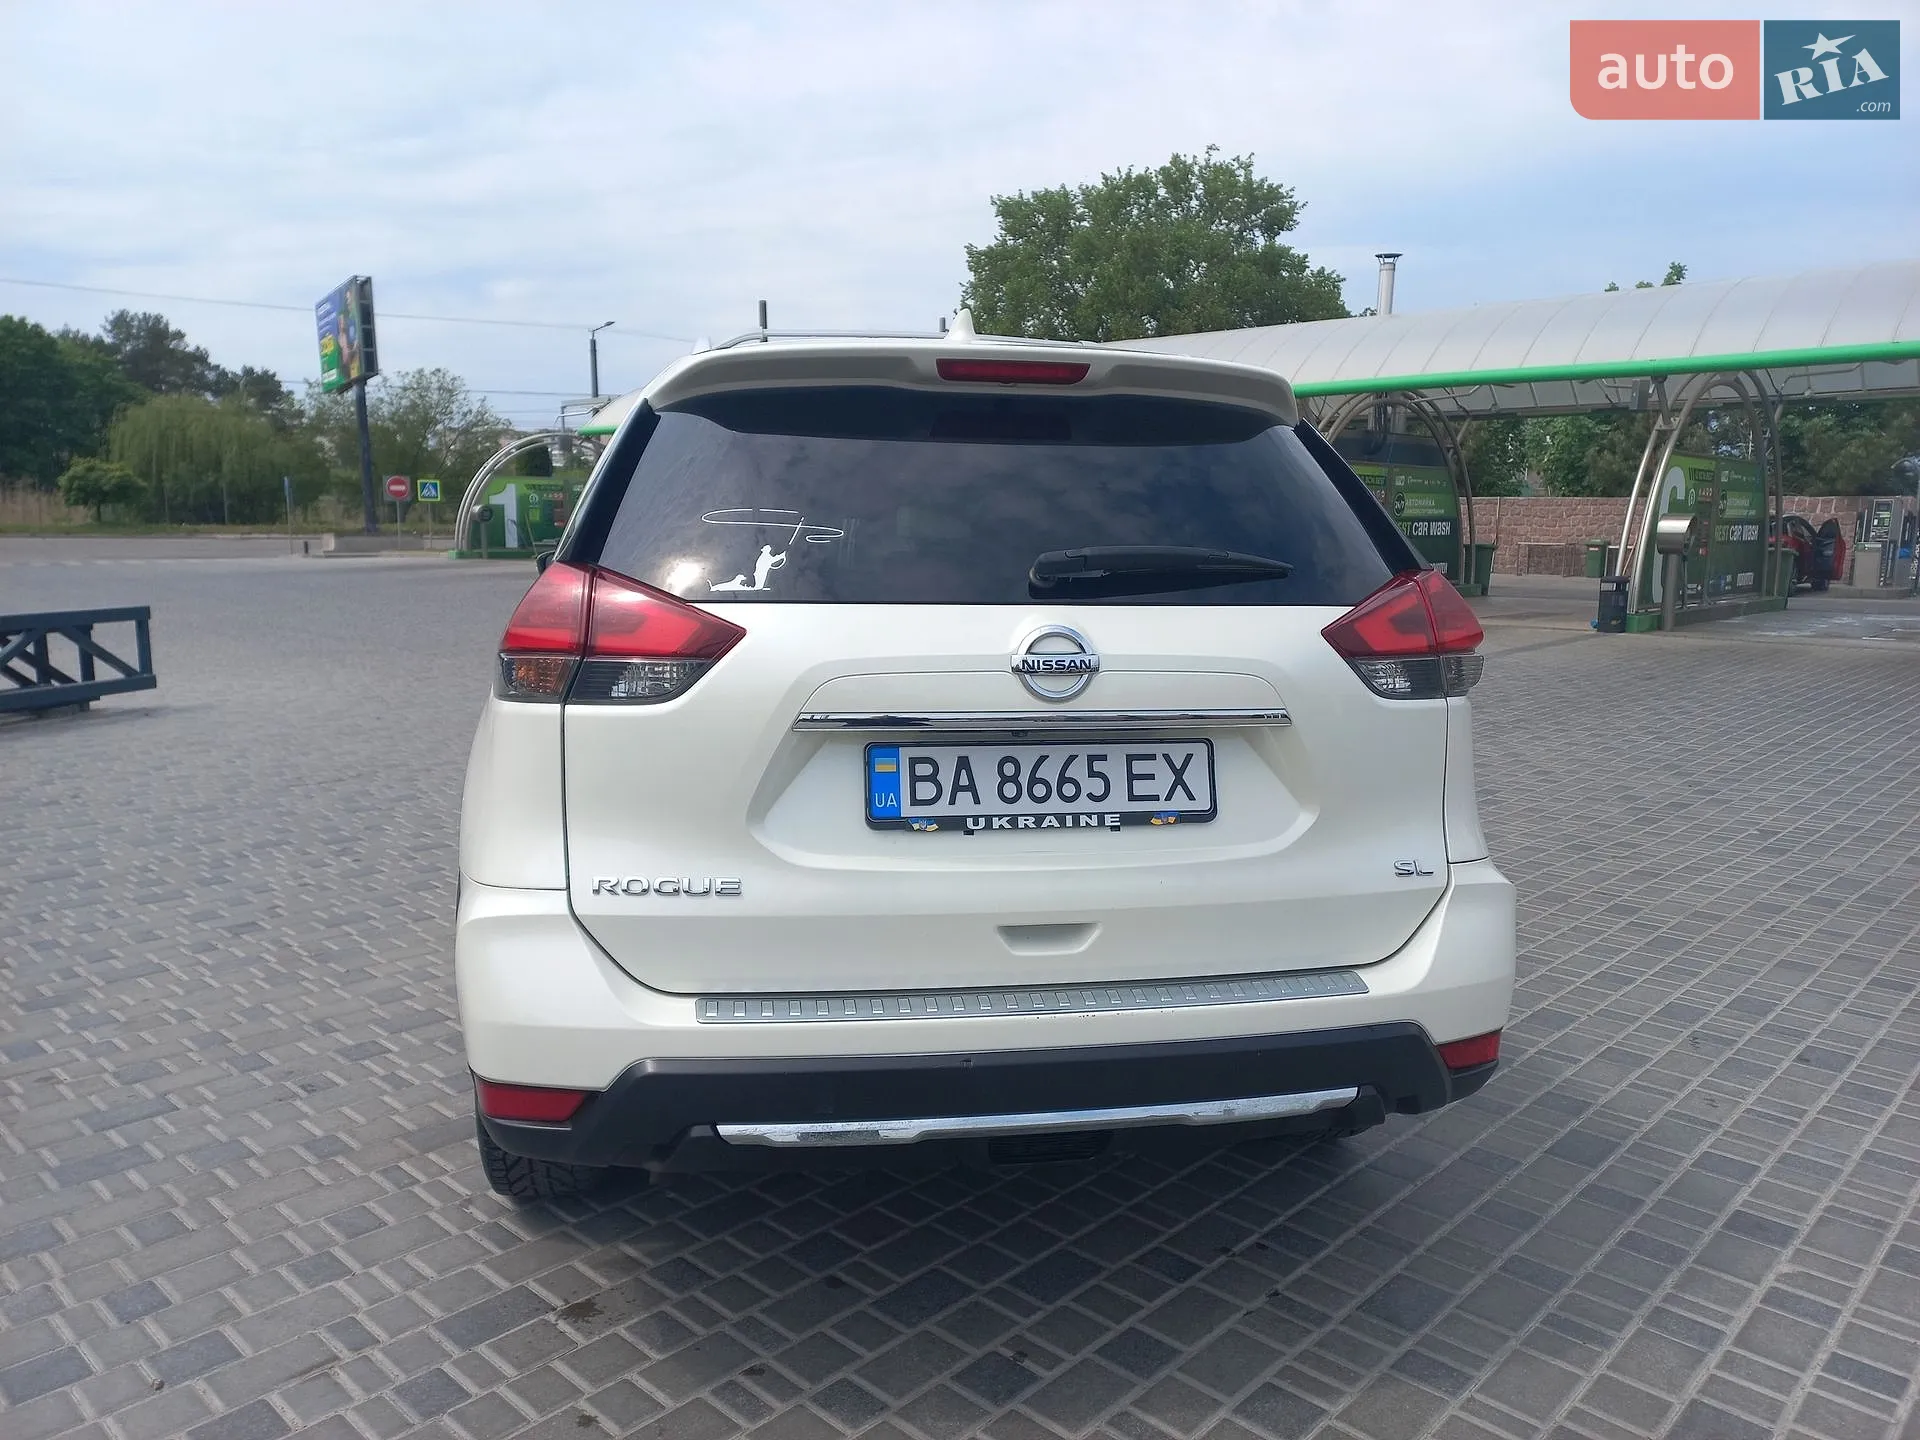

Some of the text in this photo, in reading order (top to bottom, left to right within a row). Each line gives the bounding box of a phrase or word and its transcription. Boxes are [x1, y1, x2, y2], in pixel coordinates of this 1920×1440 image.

[488, 483, 519, 548] 1
[1021, 659, 1092, 671] NISSAN
[908, 753, 1197, 807] BA 8665 EX
[874, 791, 898, 808] UA
[966, 813, 1121, 831] UKRAINE
[1394, 860, 1434, 877] SL
[592, 875, 743, 897] ROGUE
